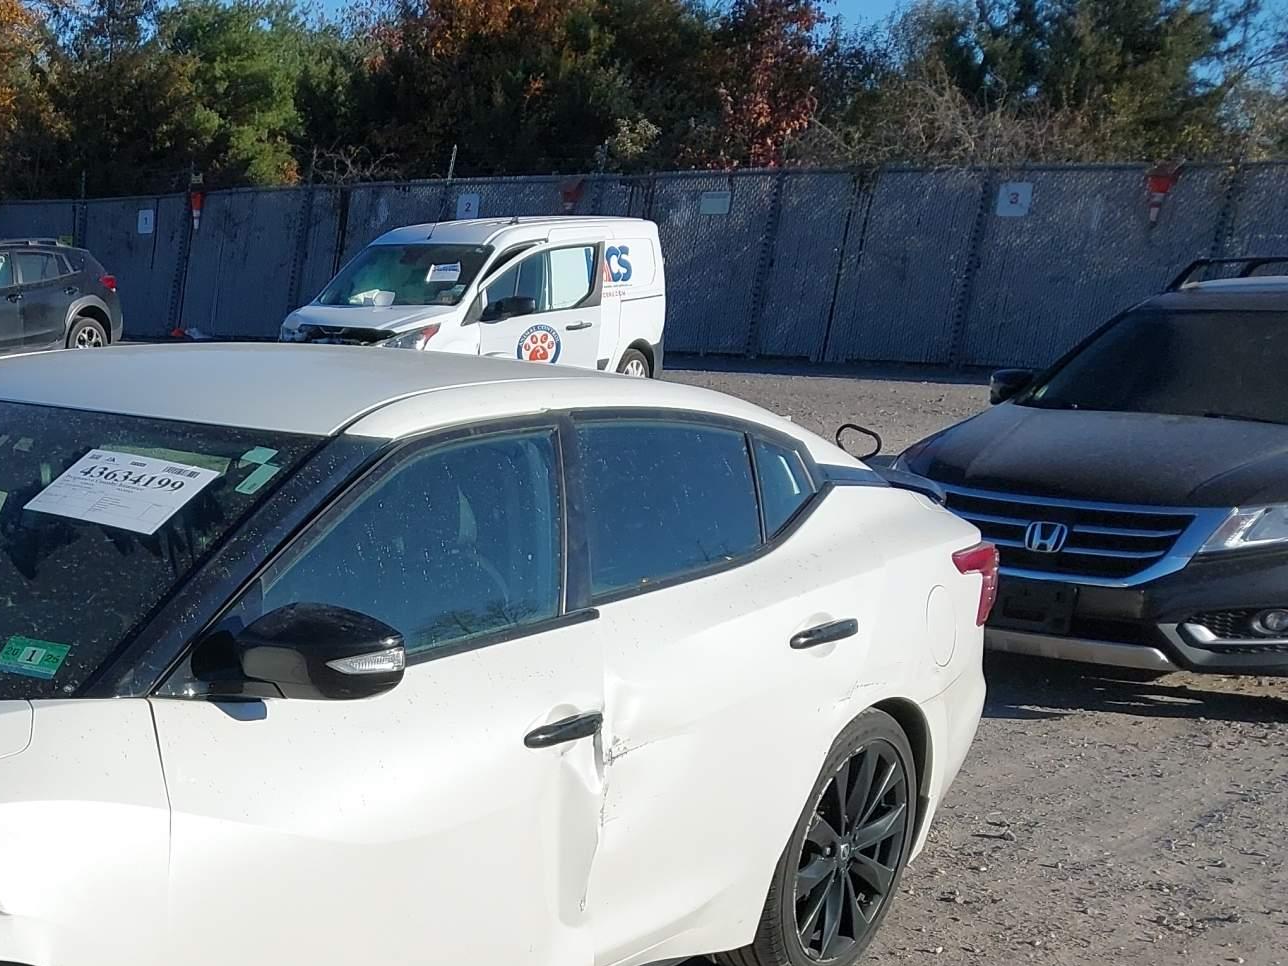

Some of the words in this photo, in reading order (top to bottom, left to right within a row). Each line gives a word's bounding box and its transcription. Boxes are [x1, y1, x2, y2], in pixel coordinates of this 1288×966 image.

[1008, 192, 1020, 205] 3
[464, 202, 472, 212] 2
[537, 325, 560, 344] CONTROL
[79, 464, 185, 492] 43634199
[25, 649, 37, 663] 1
